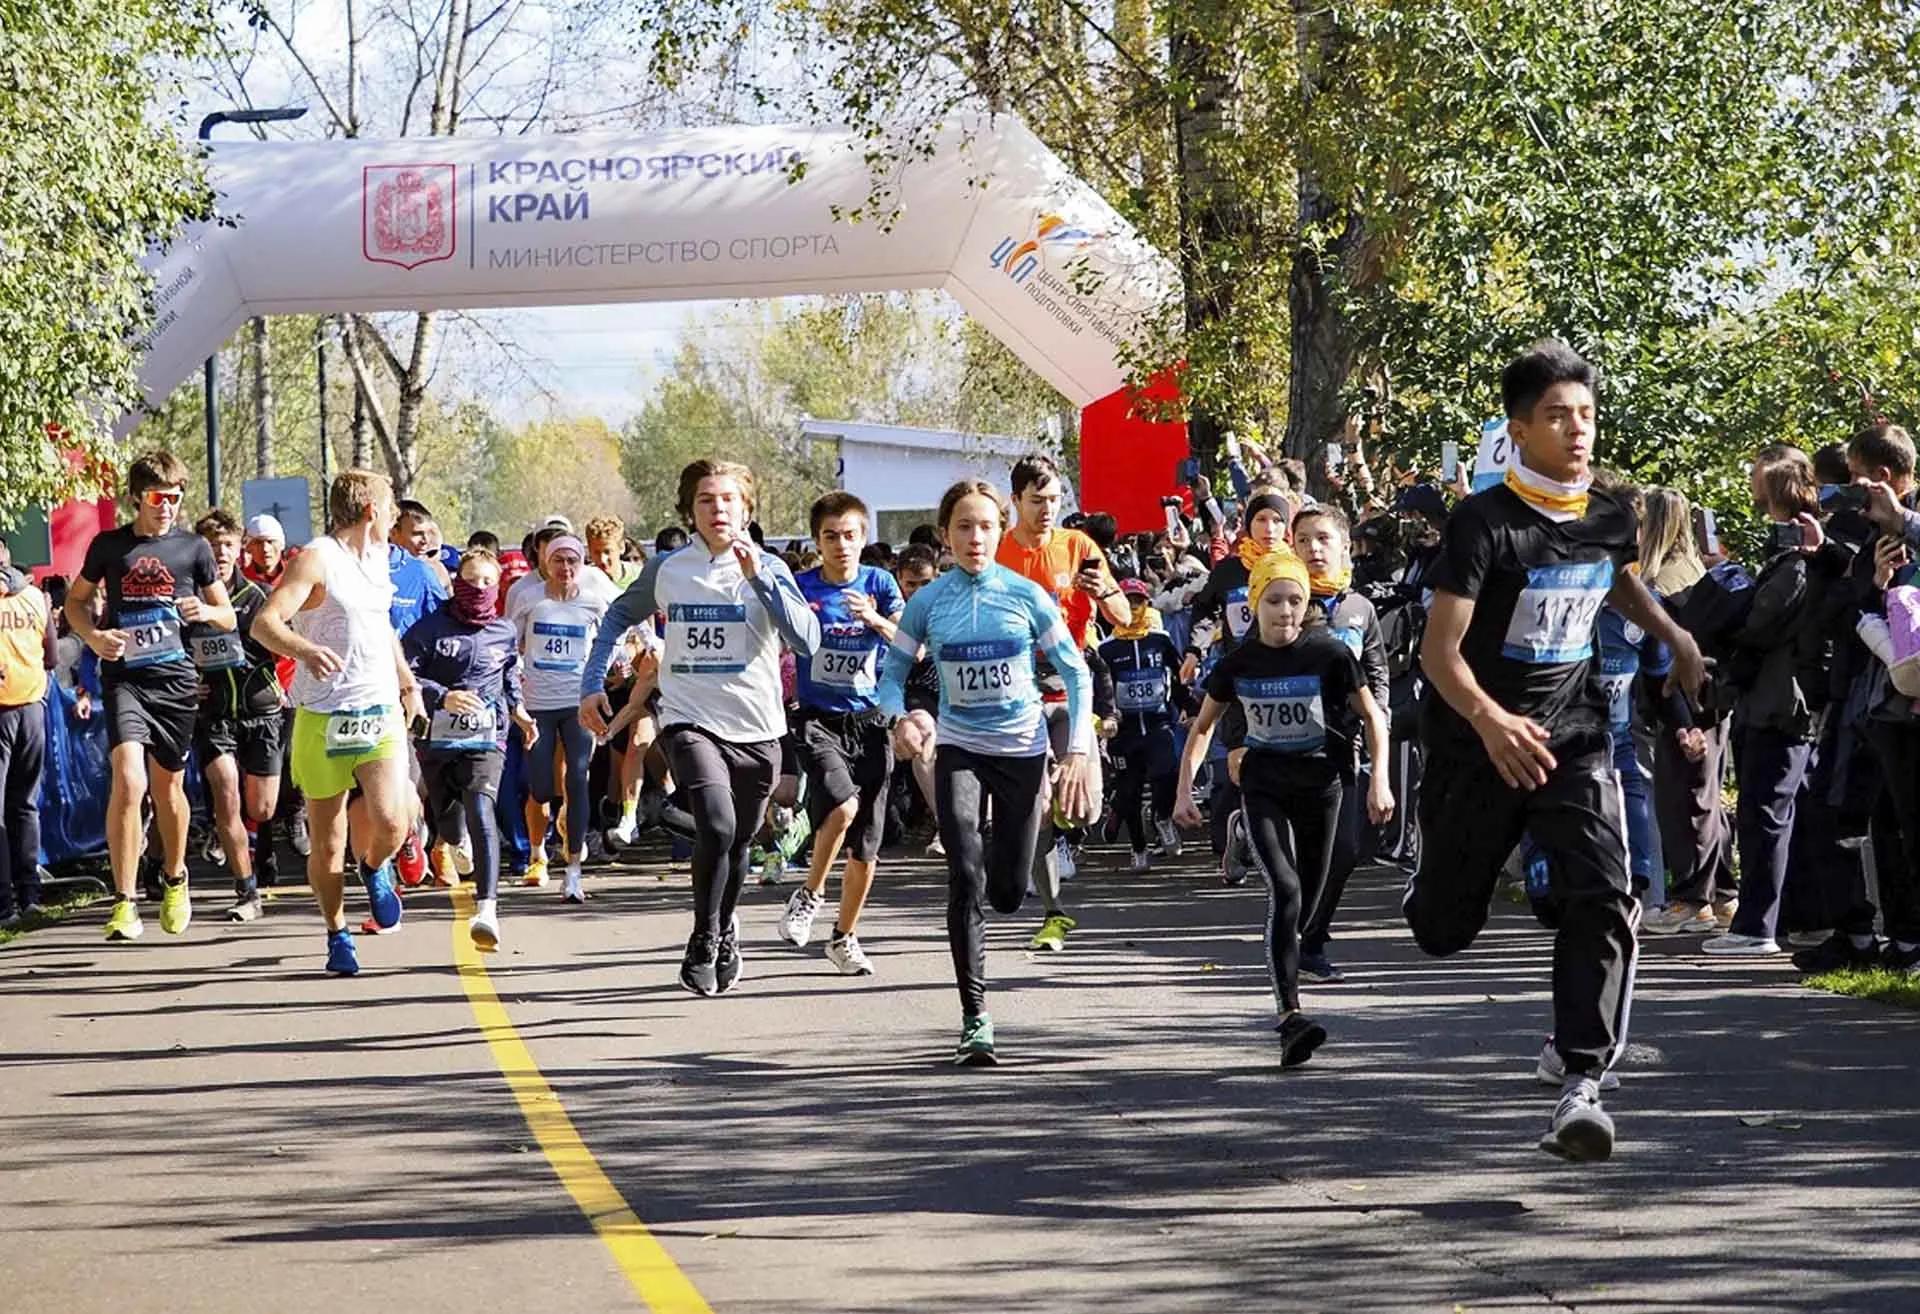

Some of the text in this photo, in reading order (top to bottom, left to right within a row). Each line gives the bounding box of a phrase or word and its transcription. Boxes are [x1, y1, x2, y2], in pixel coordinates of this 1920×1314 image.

[489, 186, 590, 223] КРАЙ
[489, 234, 840, 269] МИНИСТЕРСТВО СПОРТА
[1037, 268, 1068, 297] ЦЕНТР
[1024, 281, 1083, 336] ПОДГОТОВКИ
[201, 638, 228, 656] 698
[544, 638, 571, 655] 481
[687, 626, 725, 650] 545
[956, 661, 1012, 690] 12138
[1128, 682, 1153, 697] 638
[1247, 702, 1307, 727] 3780
